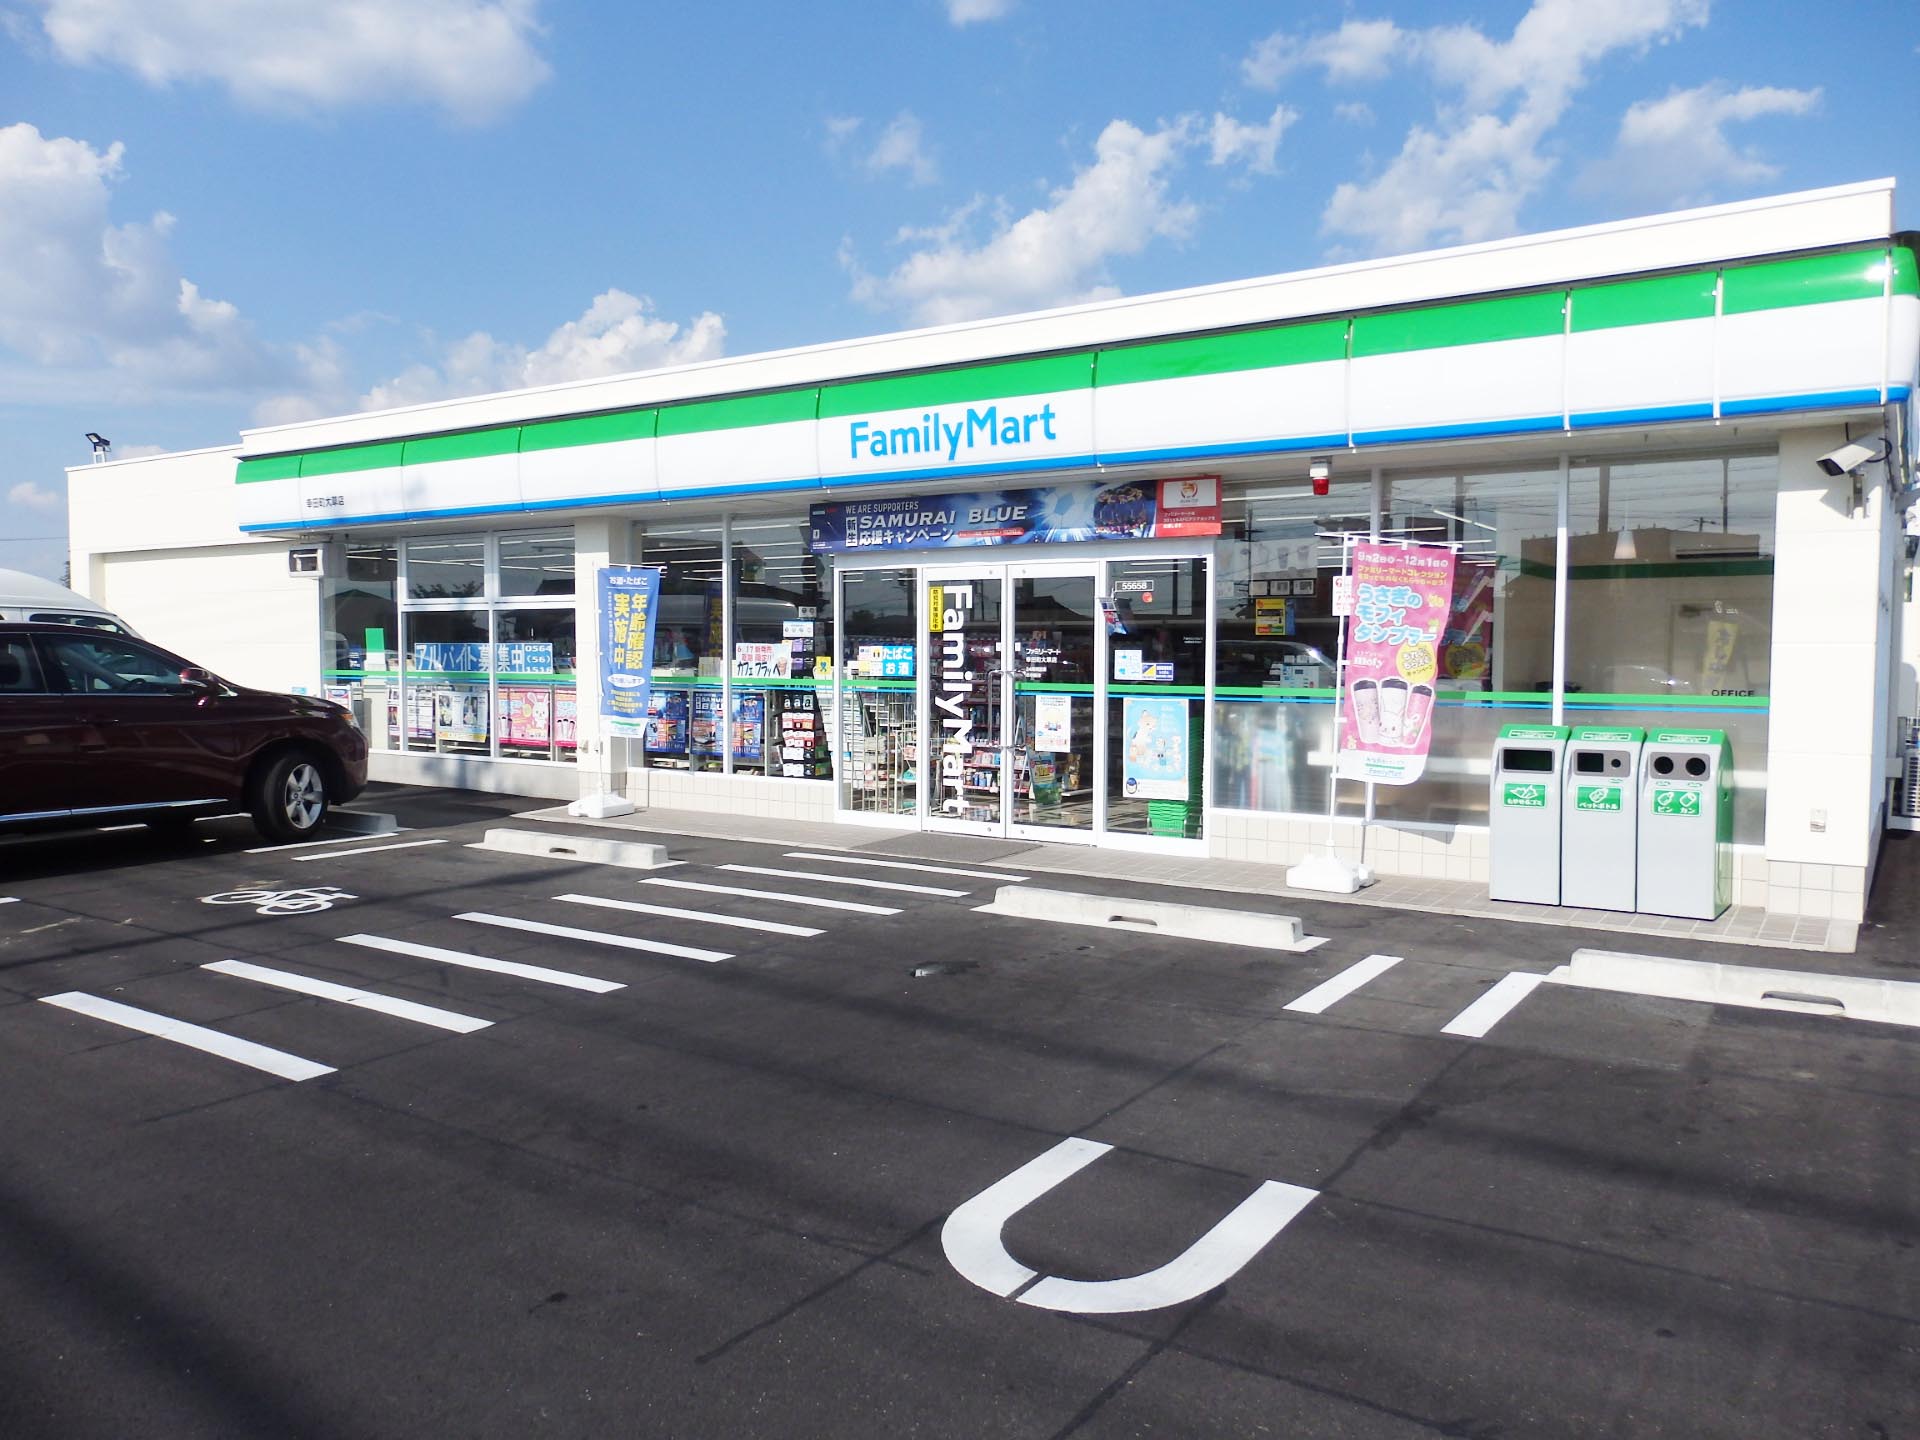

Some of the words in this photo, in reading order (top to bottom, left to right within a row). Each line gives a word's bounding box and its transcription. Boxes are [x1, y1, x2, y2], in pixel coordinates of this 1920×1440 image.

[851, 403, 1056, 461] FamilyMart
[846, 505, 857, 515] WE
[858, 503, 871, 514] ARE
[874, 501, 919, 513] SUPPORTERS
[859, 510, 956, 529] SAMURAI
[968, 505, 1028, 524] BLUE
[859, 527, 953, 546] 応援キャンペーン
[1121, 582, 1148, 590] 55658
[1358, 584, 1422, 608] うさぎの
[1355, 604, 1406, 625] モフィ
[626, 593, 648, 669] 年齢確認
[415, 643, 523, 672] アルバイト募集中
[526, 655, 551, 664] (56)
[883, 647, 912, 660] たばこ
[935, 585, 972, 815] FamilyMart
[1711, 689, 1755, 697] OFFICE
[1578, 802, 1619, 810] ペットボトル
